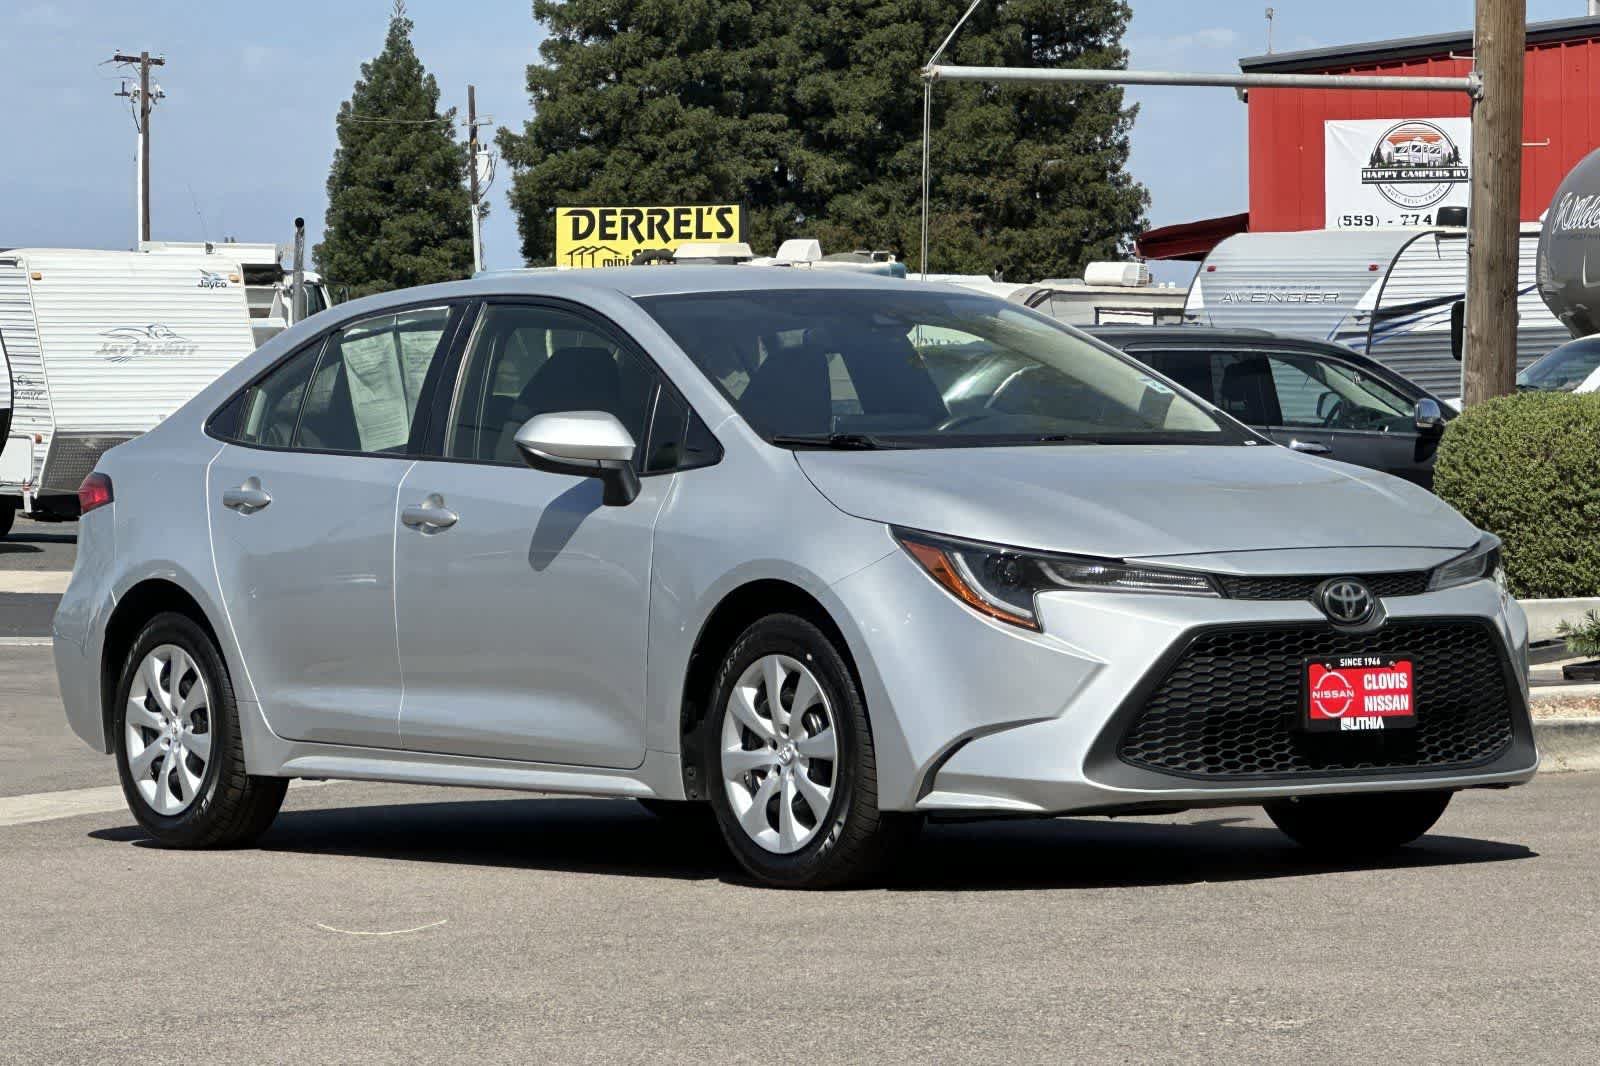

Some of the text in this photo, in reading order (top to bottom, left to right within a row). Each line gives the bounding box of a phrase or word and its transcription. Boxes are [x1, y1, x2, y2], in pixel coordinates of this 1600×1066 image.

[1362, 169, 1468, 179] HAPPY CAMPERS RV
[563, 207, 734, 244] DERREL'S
[1338, 215, 1380, 228] (559)
[602, 252, 630, 268] mini
[198, 280, 227, 289] Jayco
[1220, 292, 1340, 304] AVENGER
[1340, 658, 1362, 667] SINCE
[1363, 672, 1408, 691] CLOVIS
[1312, 690, 1354, 699] NISSAN
[1364, 694, 1409, 712] NISSAN
